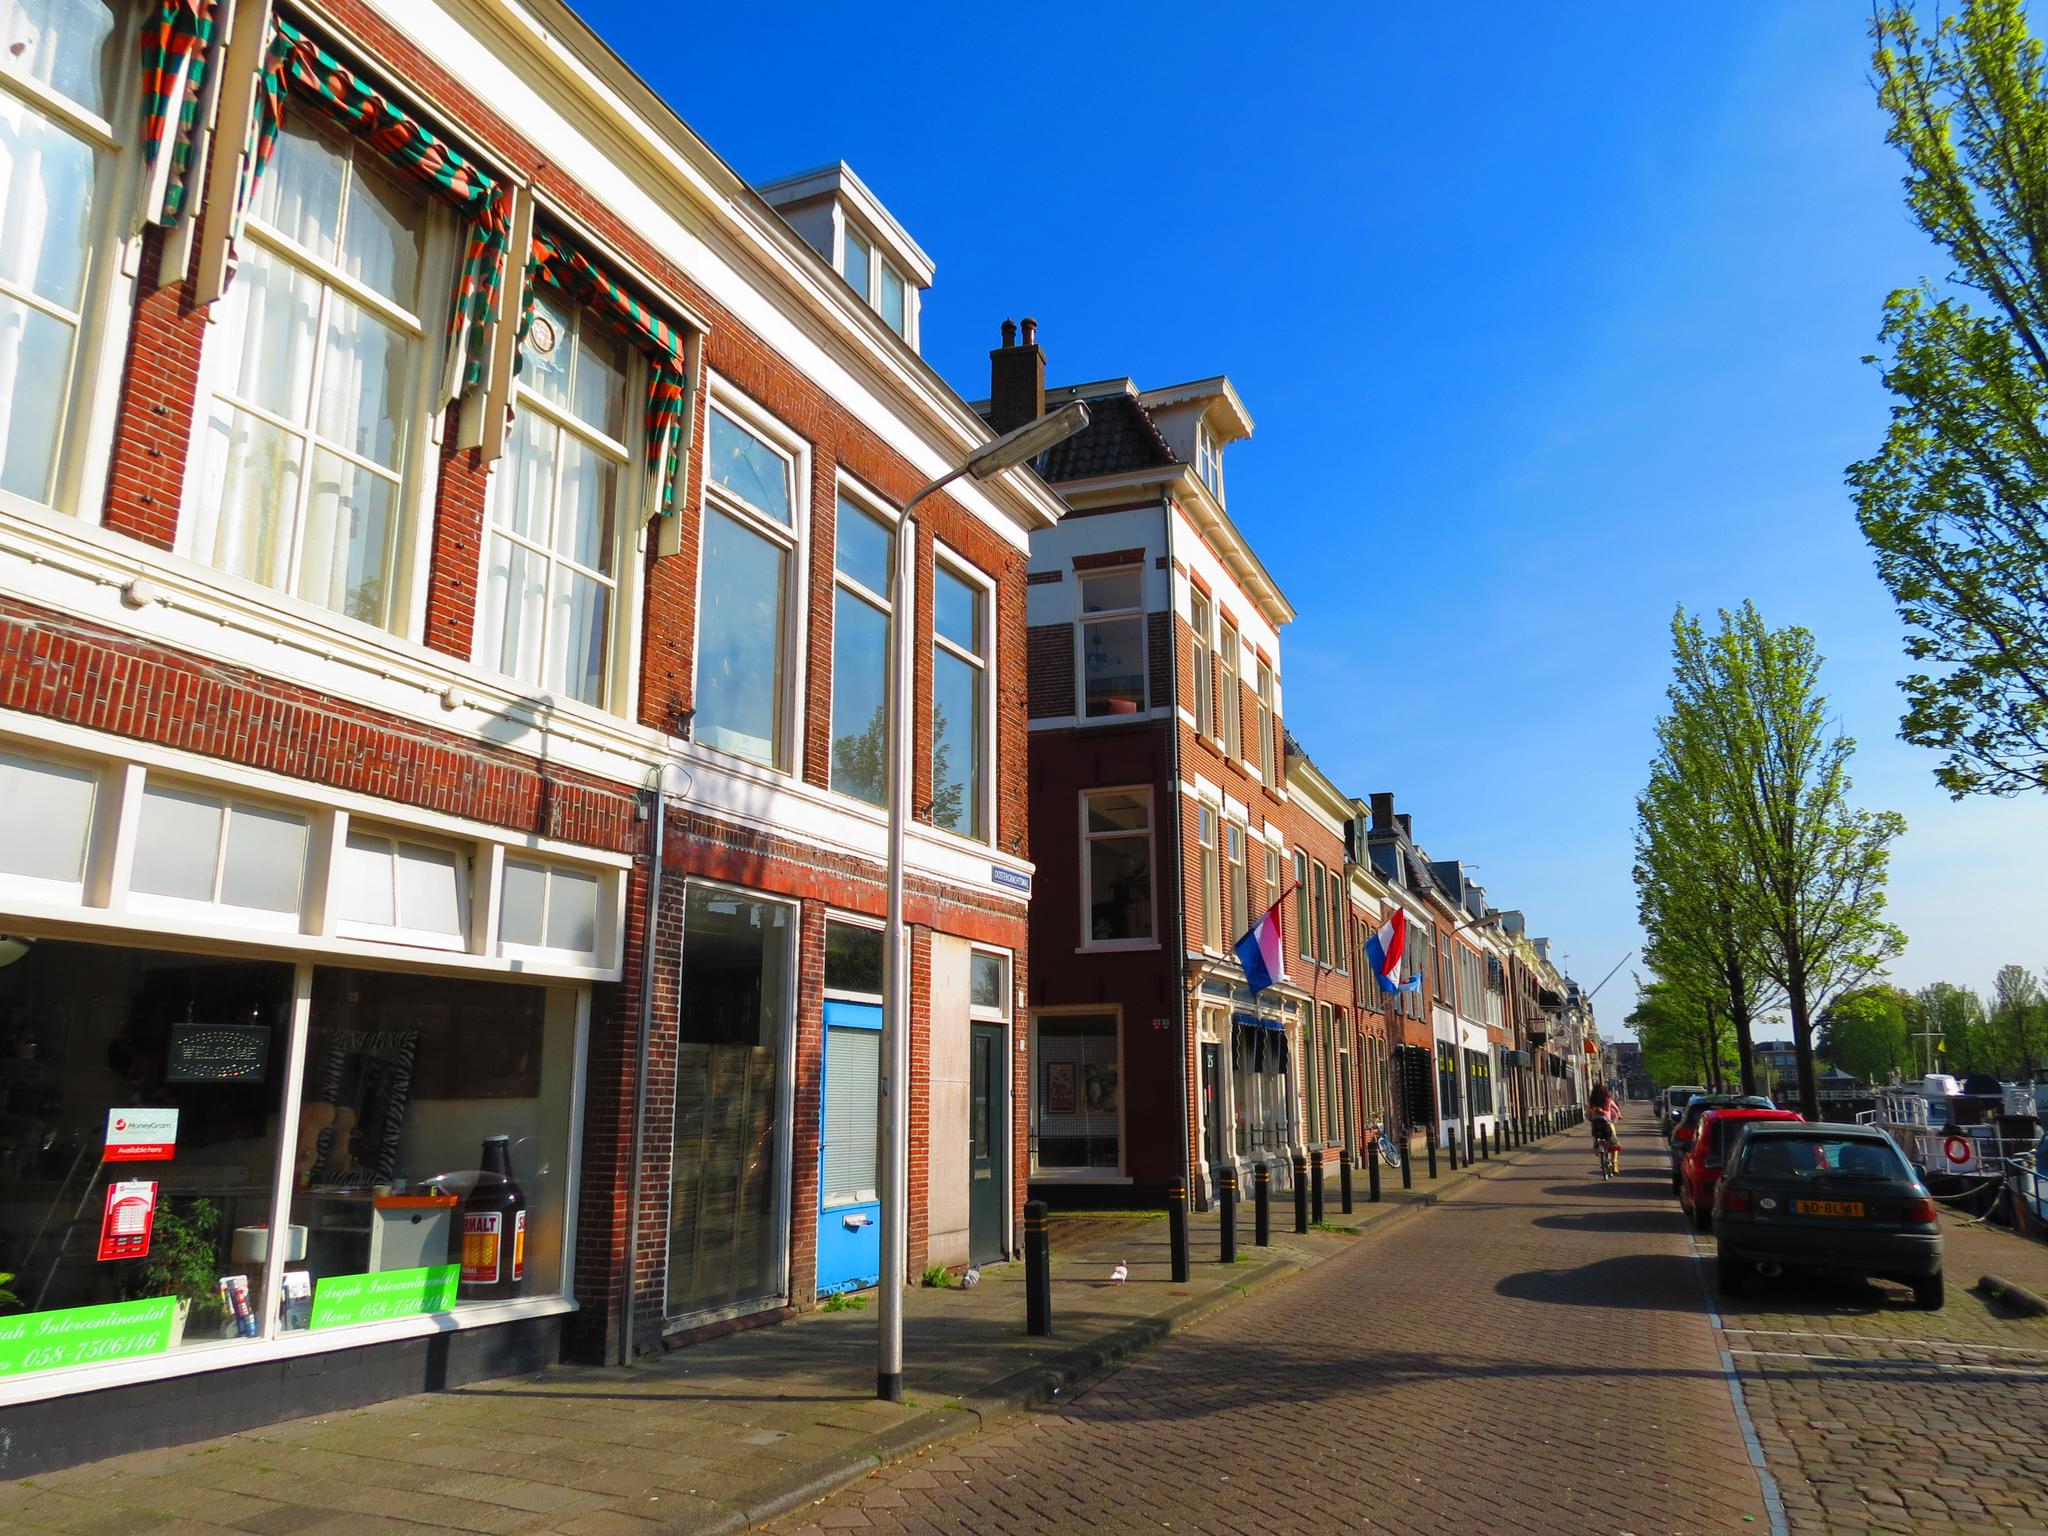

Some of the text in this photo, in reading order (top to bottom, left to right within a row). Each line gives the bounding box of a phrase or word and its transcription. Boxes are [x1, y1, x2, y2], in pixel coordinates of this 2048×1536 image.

[182, 1045, 257, 1061] WELCOME
[128, 1122, 172, 1130] MoneyGram
[368, 1270, 456, 1295] Intercontinental
[359, 1293, 451, 1319] 058-7506146
[35, 1304, 169, 1336] Intercontinental
[22, 1331, 160, 1368] 058-7506146
